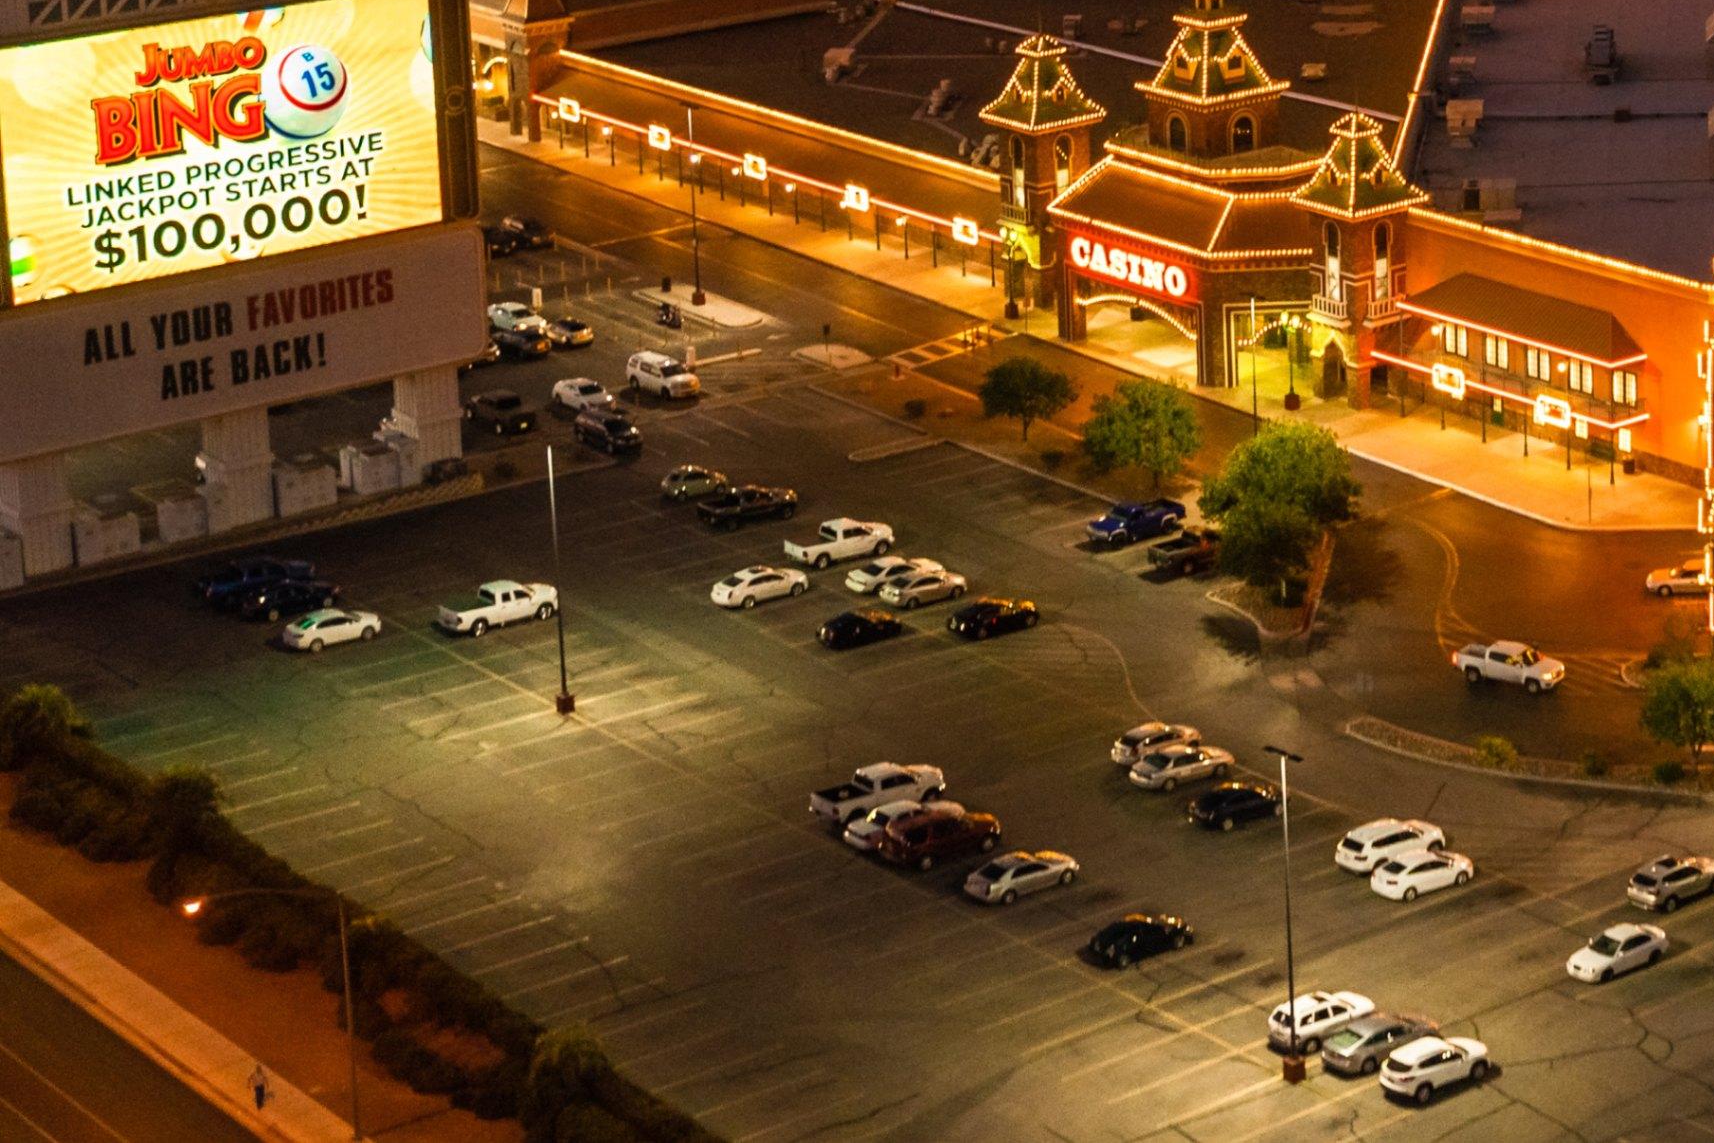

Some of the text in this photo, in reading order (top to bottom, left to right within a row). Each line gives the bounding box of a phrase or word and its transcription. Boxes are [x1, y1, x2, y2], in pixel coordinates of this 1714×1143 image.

[135, 36, 266, 86] JUMBO
[301, 62, 336, 99] 15
[67, 132, 384, 206] LINKED PROGRESSIVE
[81, 157, 376, 228] JACKPOT STARTS AT
[94, 184, 367, 274] $100,000!
[1070, 236, 1188, 297] CASINO
[84, 268, 394, 366] ALL YOUR FAVORITES
[161, 332, 327, 400] ARE BACK!
